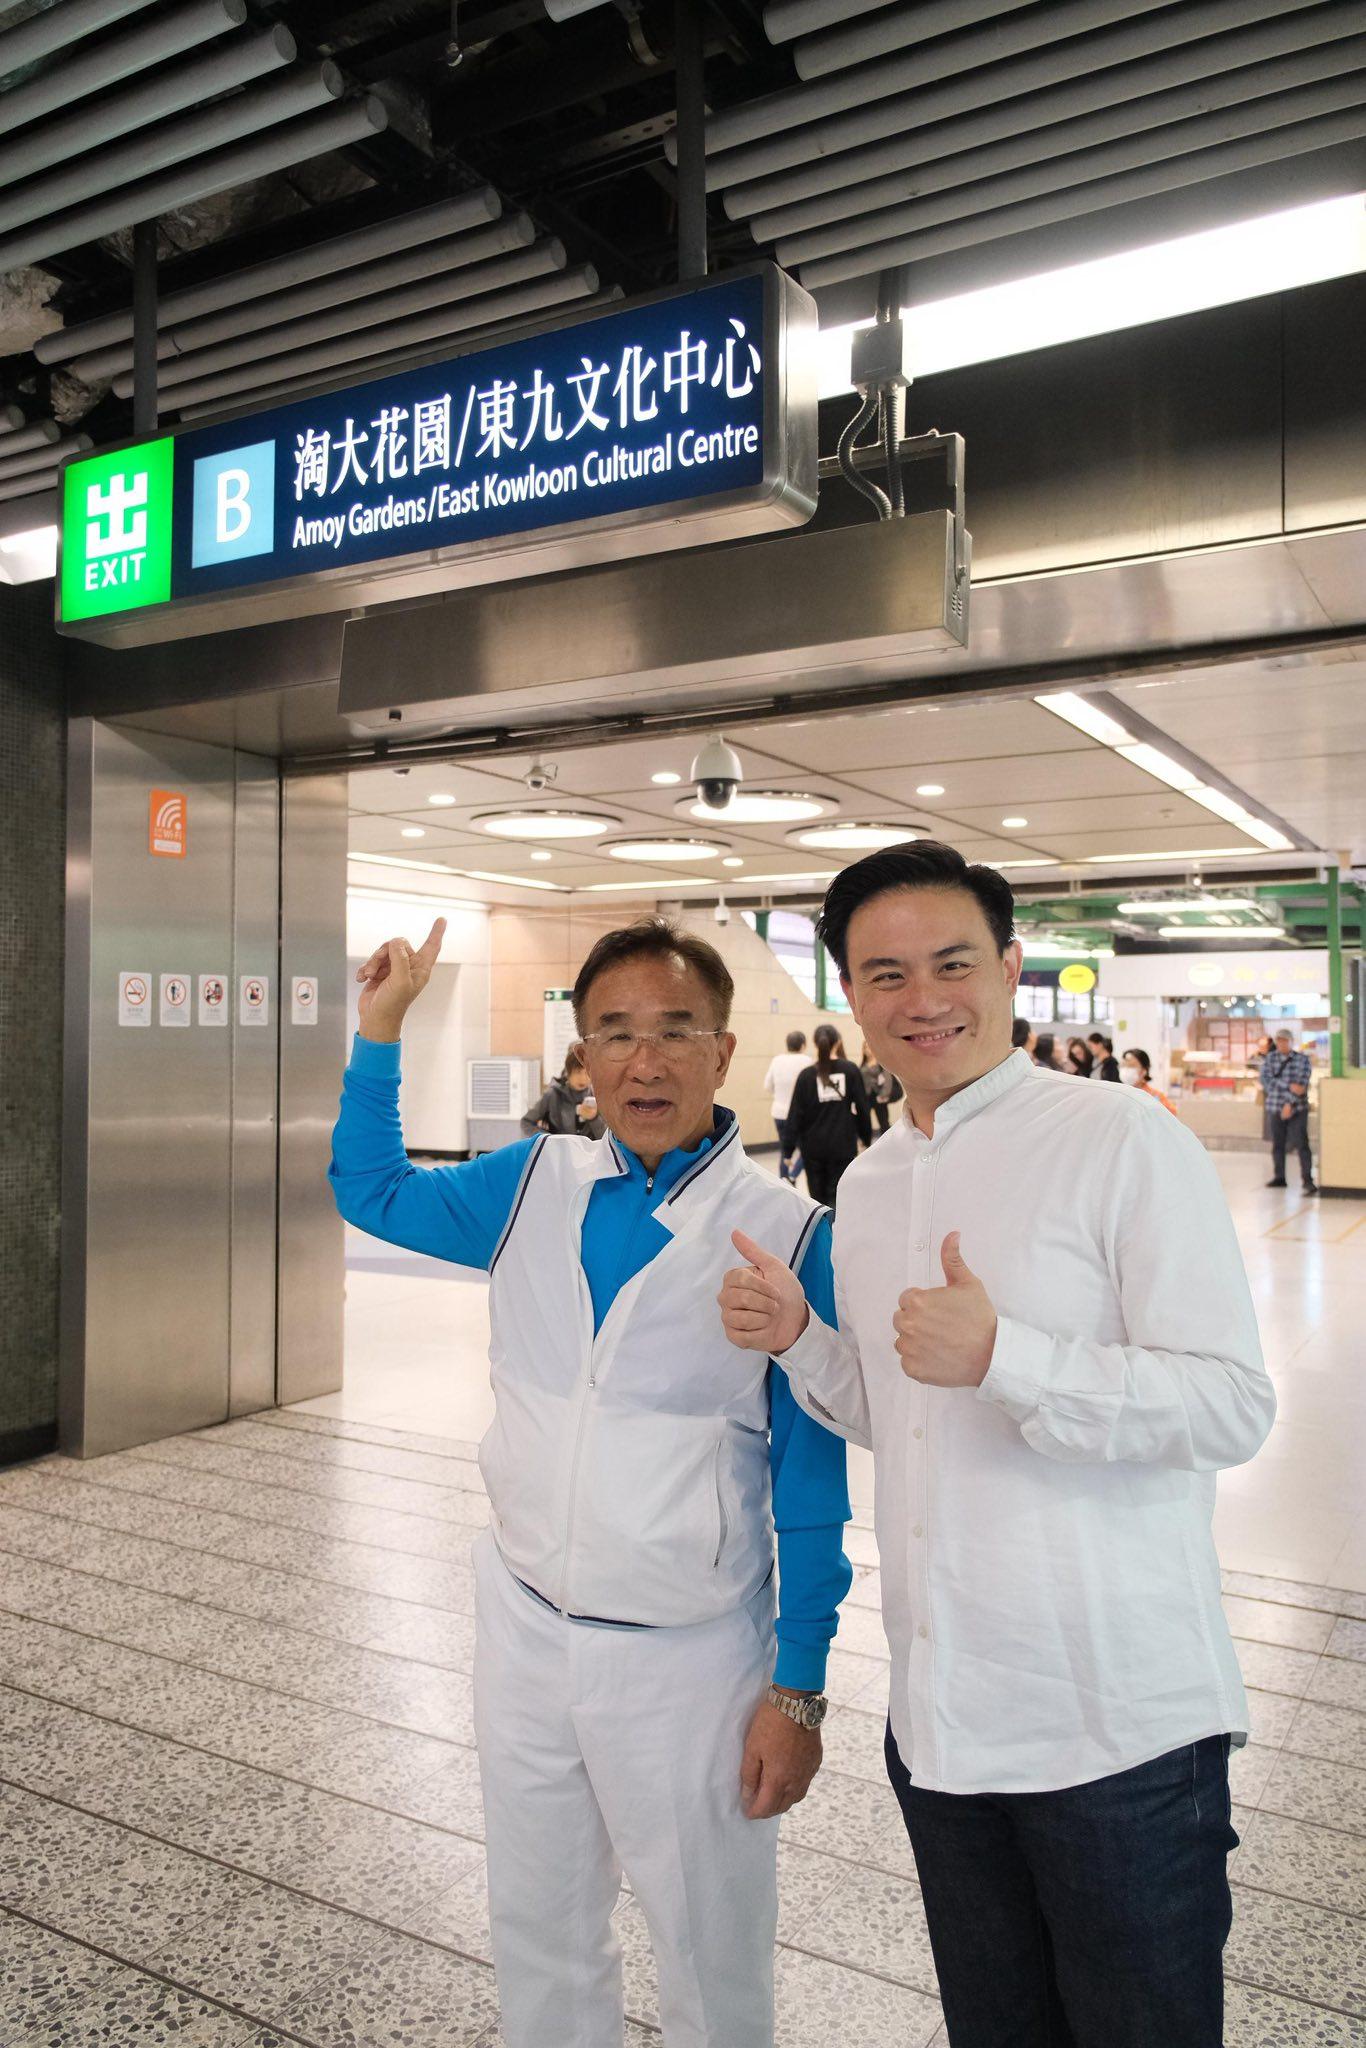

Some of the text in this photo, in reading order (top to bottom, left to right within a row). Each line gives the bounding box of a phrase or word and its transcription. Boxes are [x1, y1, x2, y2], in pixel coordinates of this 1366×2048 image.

[293, 318, 761, 501] 淘大花園/東九文化中心
[85, 471, 148, 560] 出
[216, 468, 251, 543] B
[292, 424, 758, 549] Amoy Gardens/East Kowloon Cultural Centre
[85, 552, 147, 592] EXIT
